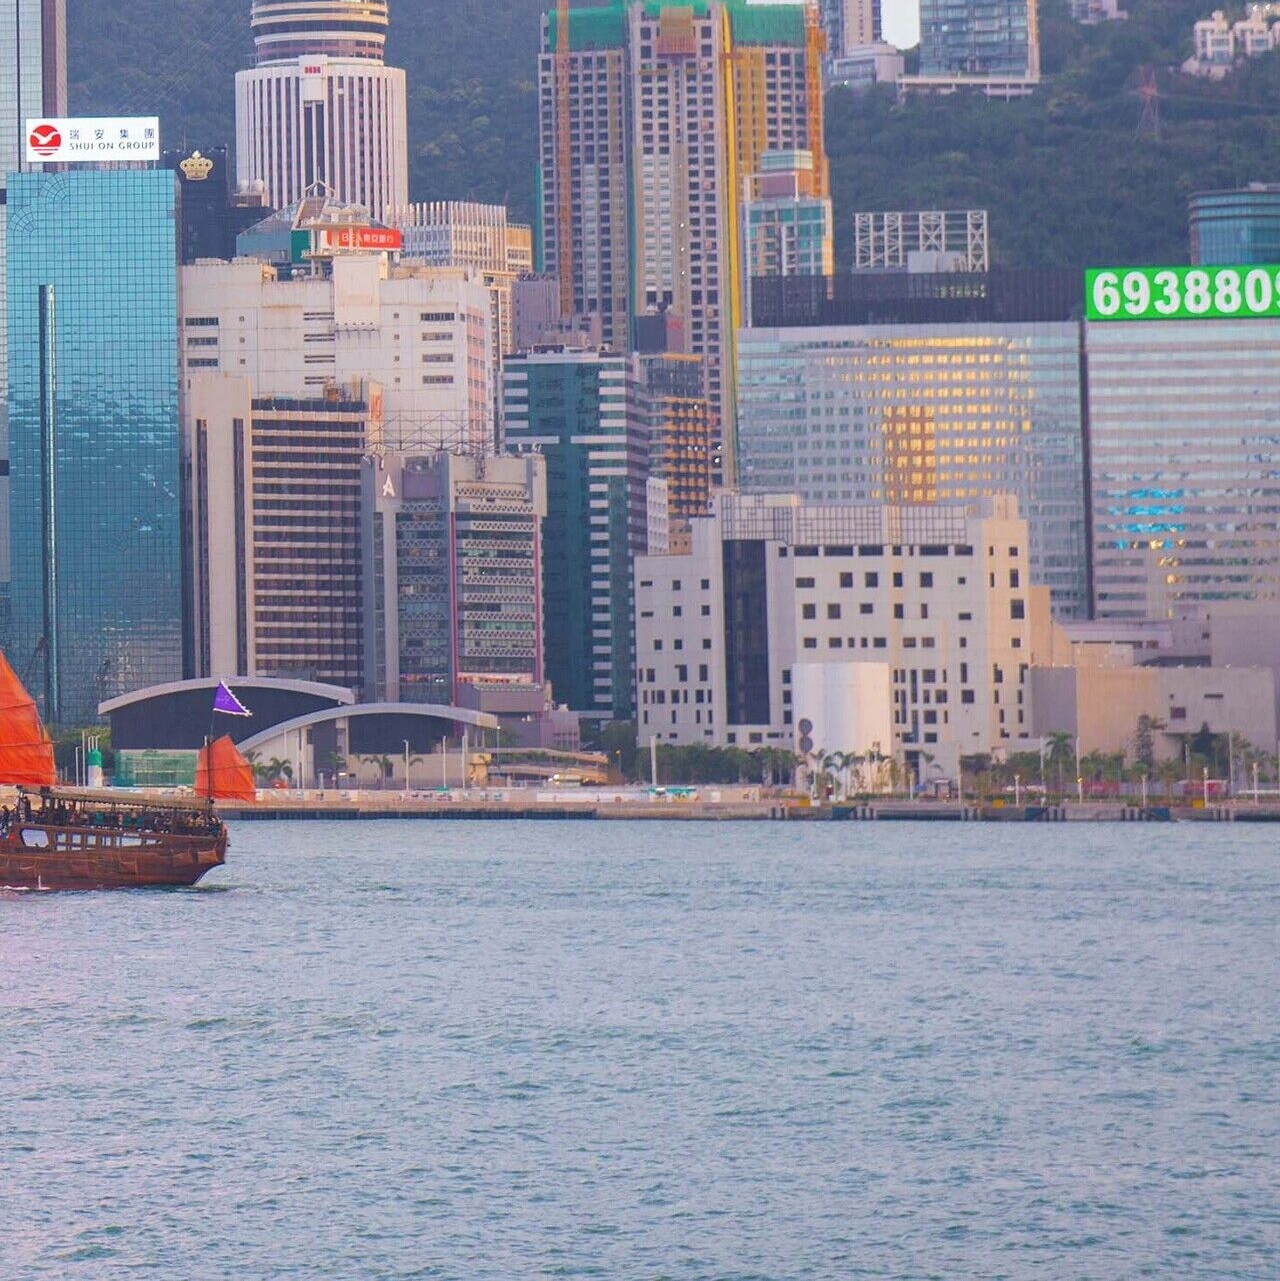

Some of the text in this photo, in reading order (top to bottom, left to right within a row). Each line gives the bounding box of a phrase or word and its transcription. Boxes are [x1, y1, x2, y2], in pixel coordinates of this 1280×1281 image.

[69, 141, 155, 150] SHUI ON GROUP
[1093, 269, 1280, 315] 693880
